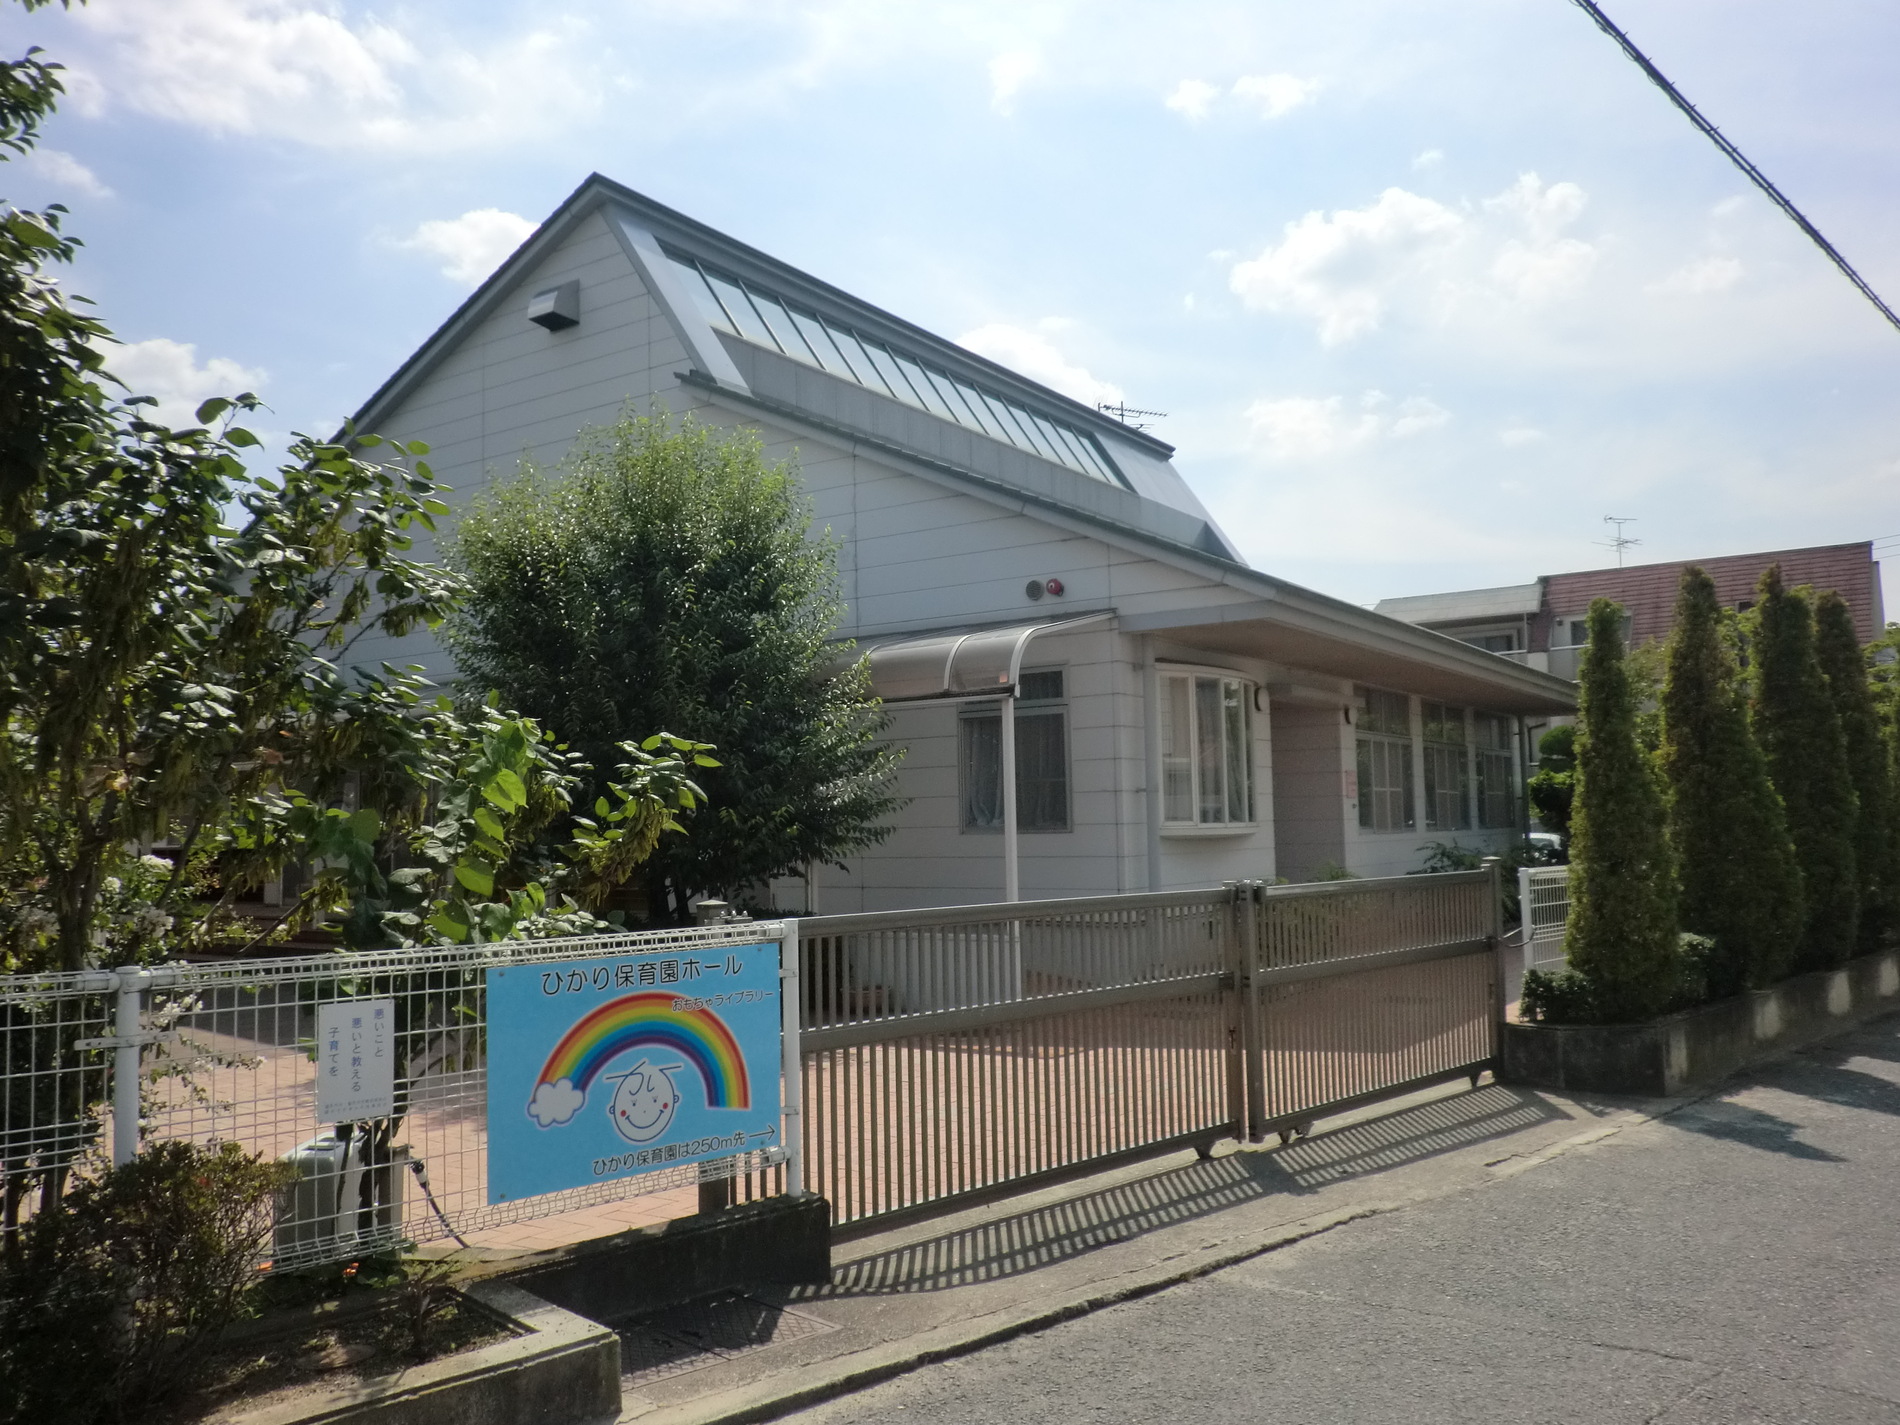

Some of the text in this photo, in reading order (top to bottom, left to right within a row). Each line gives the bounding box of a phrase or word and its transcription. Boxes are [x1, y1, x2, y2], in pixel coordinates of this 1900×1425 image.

[542, 955, 743, 995] ひかり保育園ホール
[672, 990, 773, 1012] おもちゃライブラリー
[329, 1027, 340, 1076] 子育てを
[352, 1018, 362, 1092] 悪いと教える
[374, 1009, 384, 1058] 悪いこと
[593, 1131, 746, 1176] ひかり保育園は250m先
